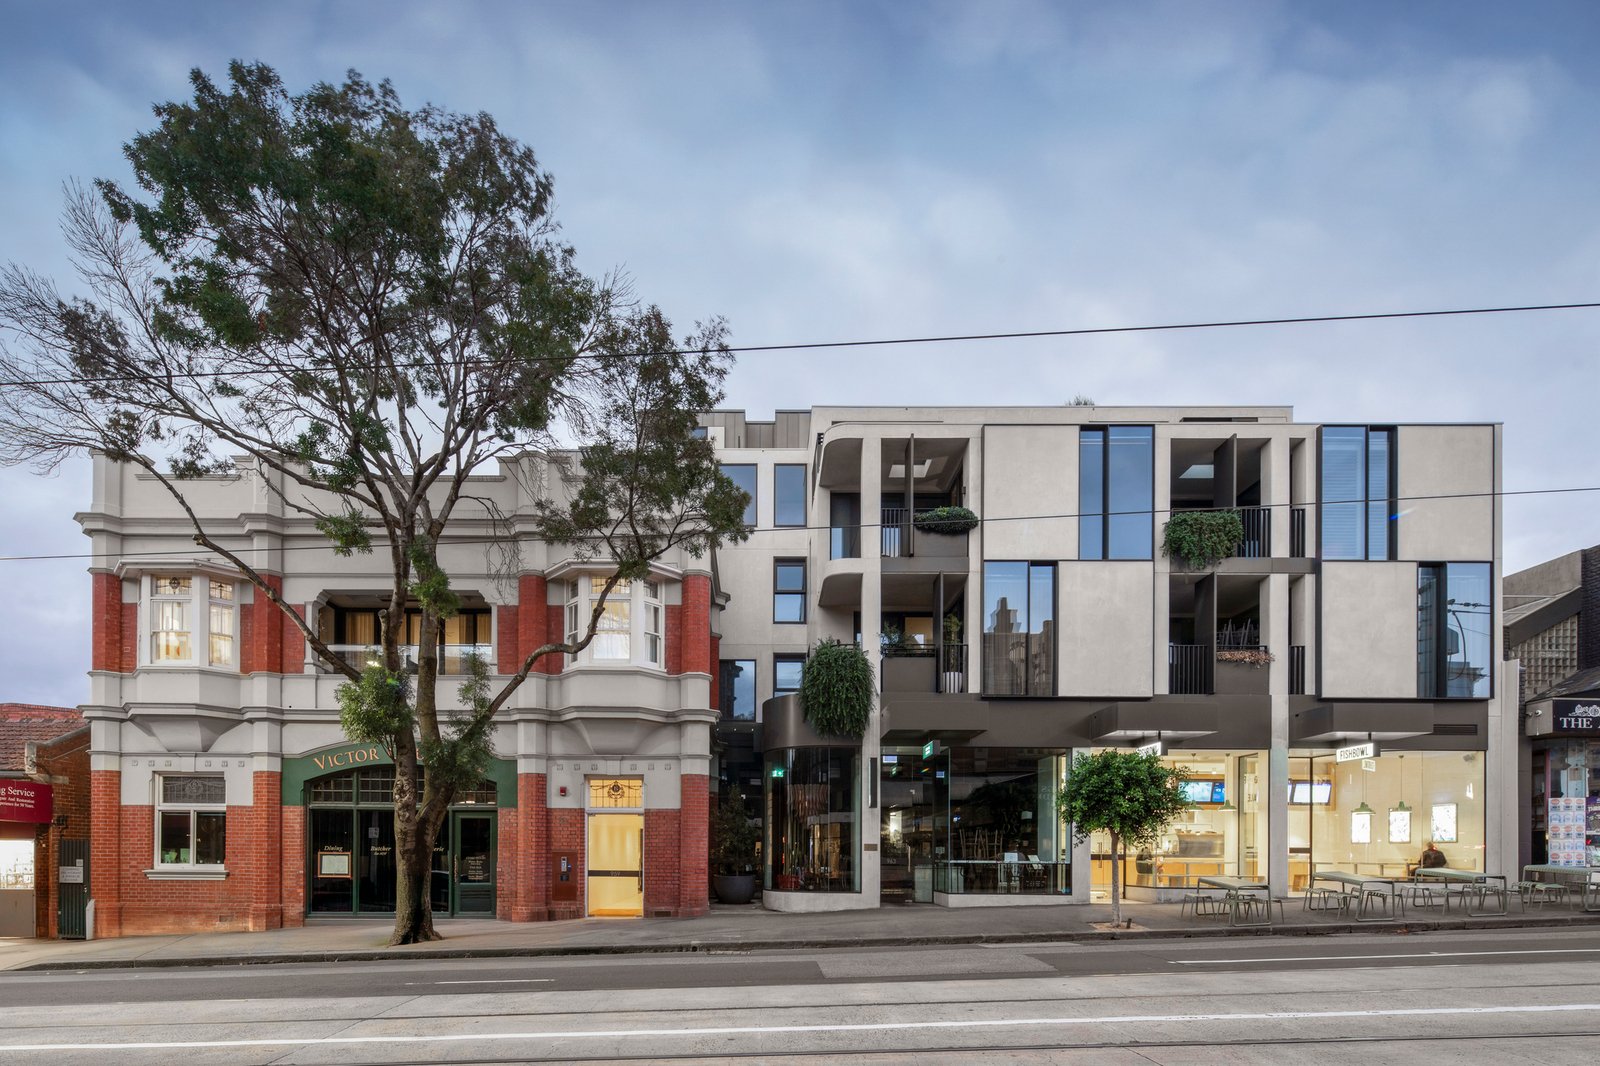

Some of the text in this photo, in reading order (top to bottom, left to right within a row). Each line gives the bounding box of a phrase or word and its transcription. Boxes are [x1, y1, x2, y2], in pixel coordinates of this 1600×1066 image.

[1560, 718, 1593, 729] THE
[313, 748, 380, 770] VICTOR
[1340, 746, 1369, 760] FISHBOWL
[8, 787, 35, 797] Service
